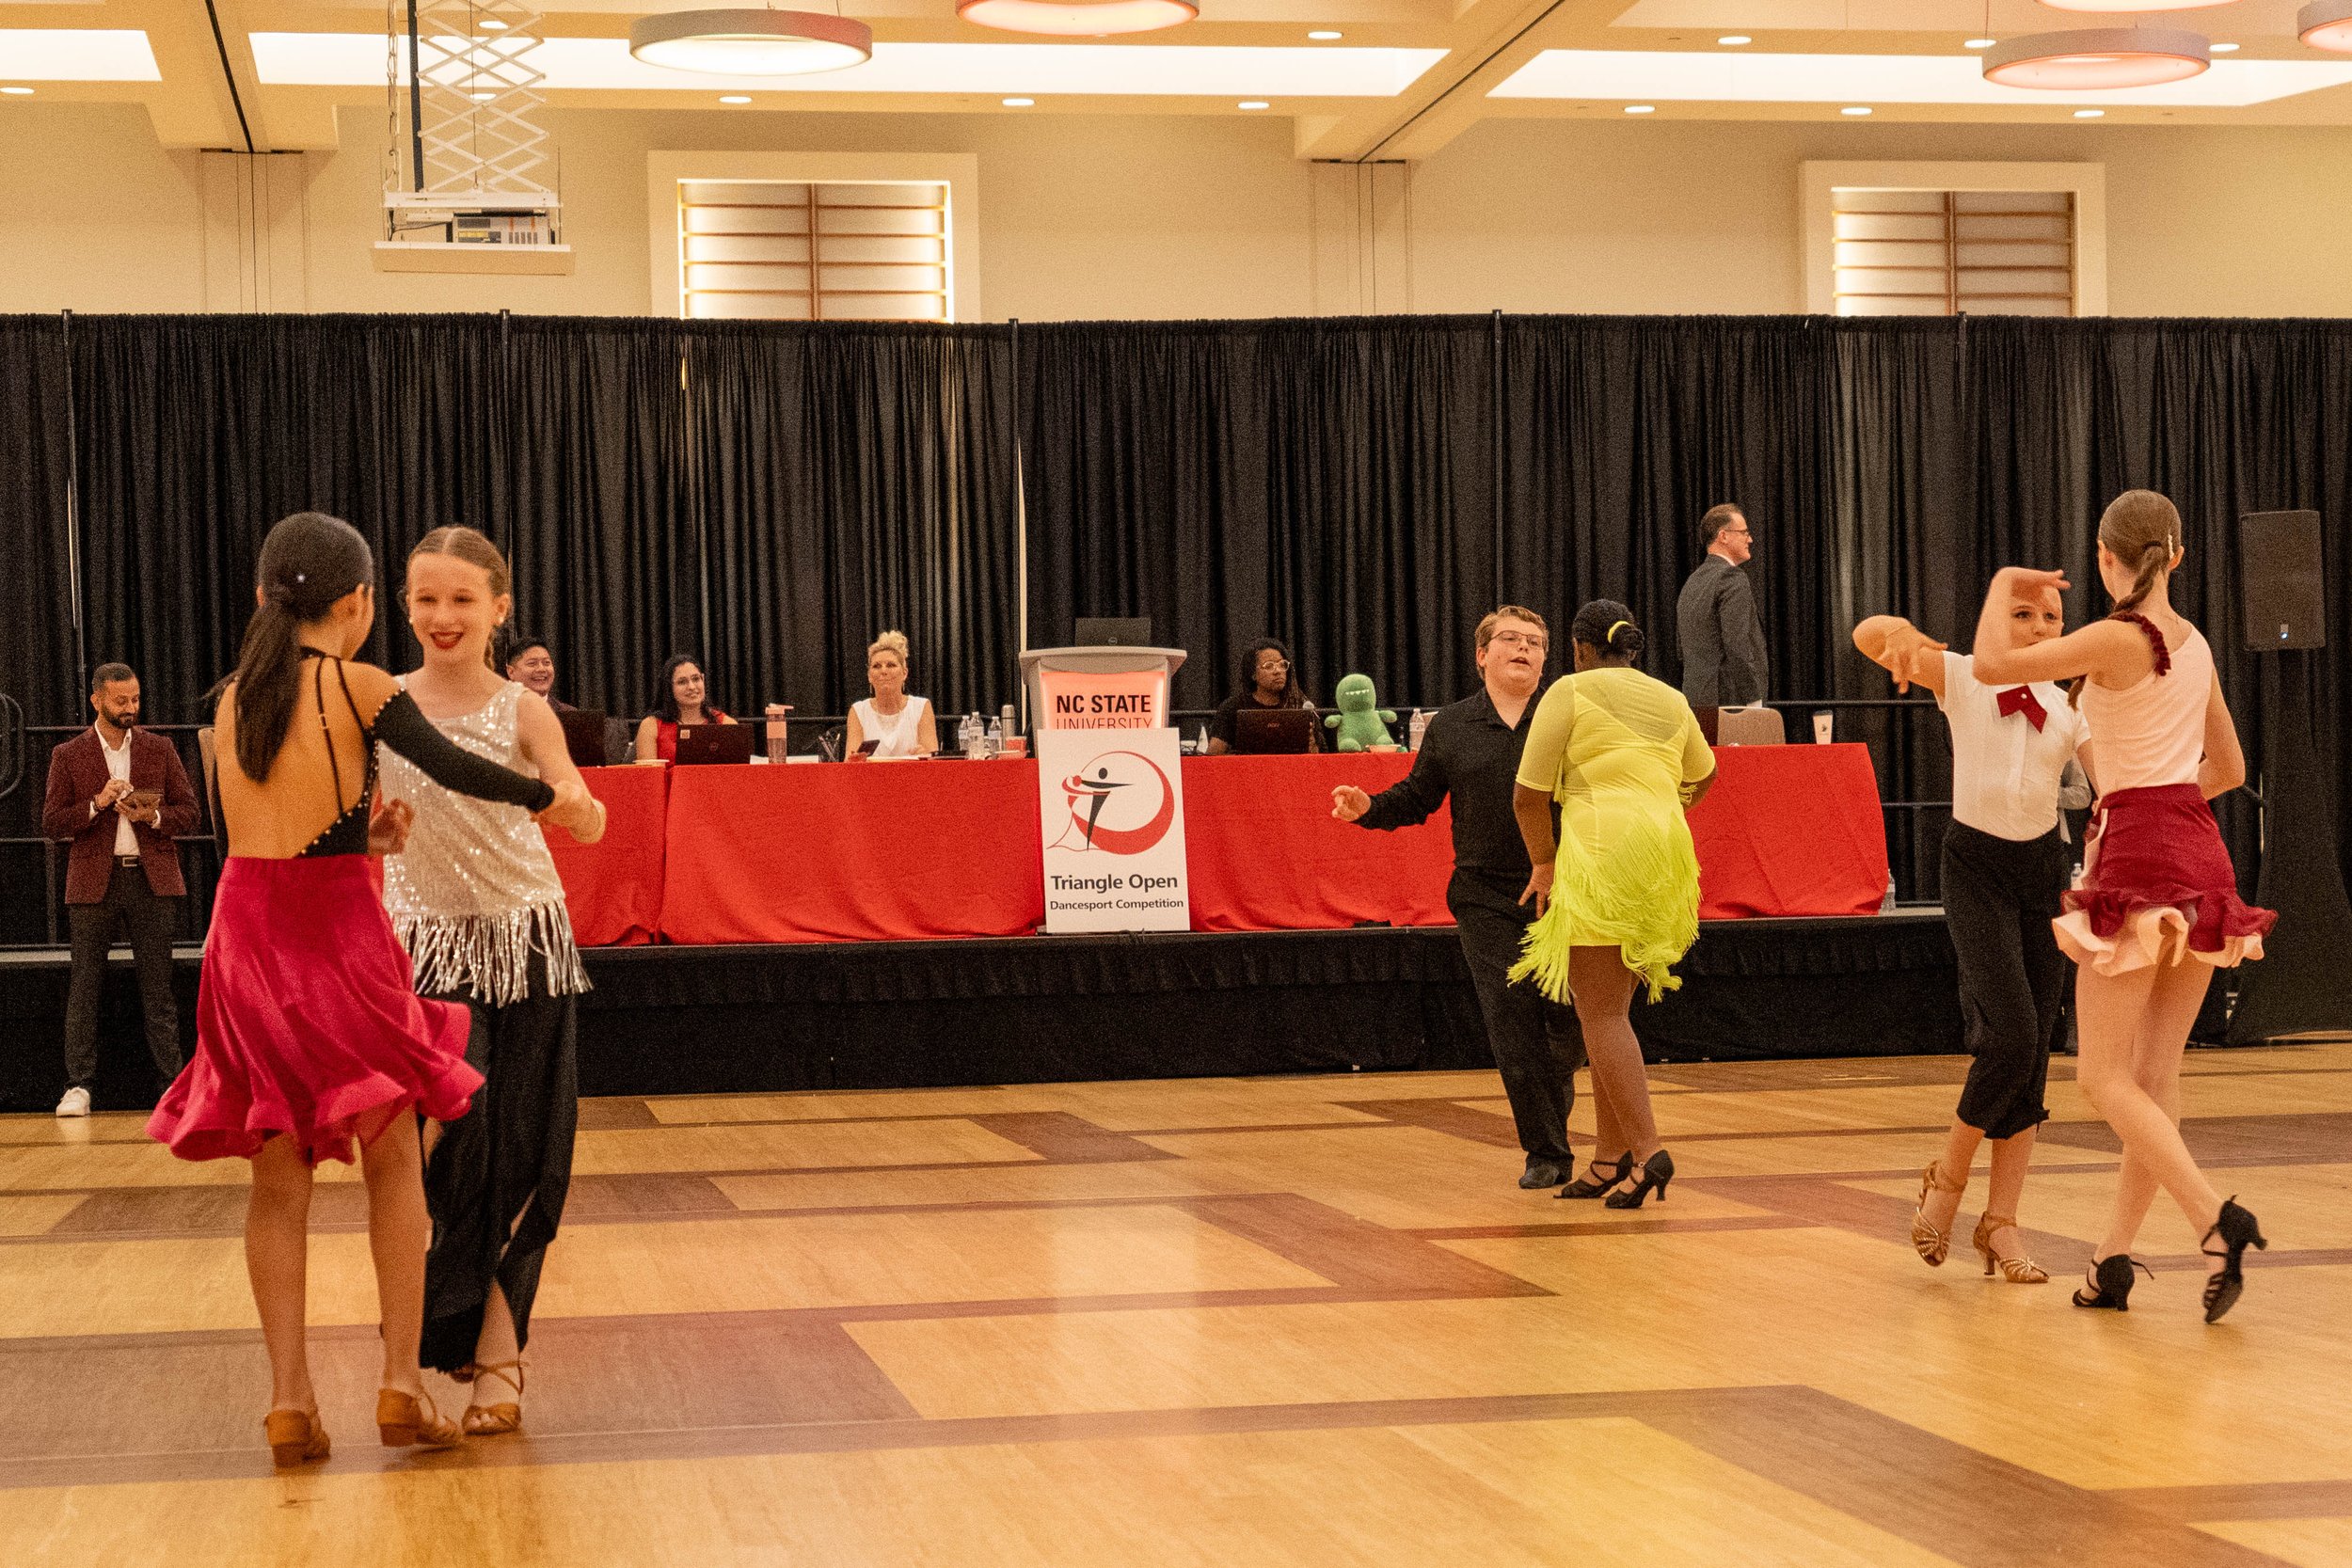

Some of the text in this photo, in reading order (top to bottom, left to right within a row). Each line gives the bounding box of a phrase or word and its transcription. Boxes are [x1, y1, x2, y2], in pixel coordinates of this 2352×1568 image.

[1057, 694, 1152, 713] NC STATE
[1050, 874, 1178, 894] Triangle Open
[1050, 898, 1184, 911] Dancesport Competition
